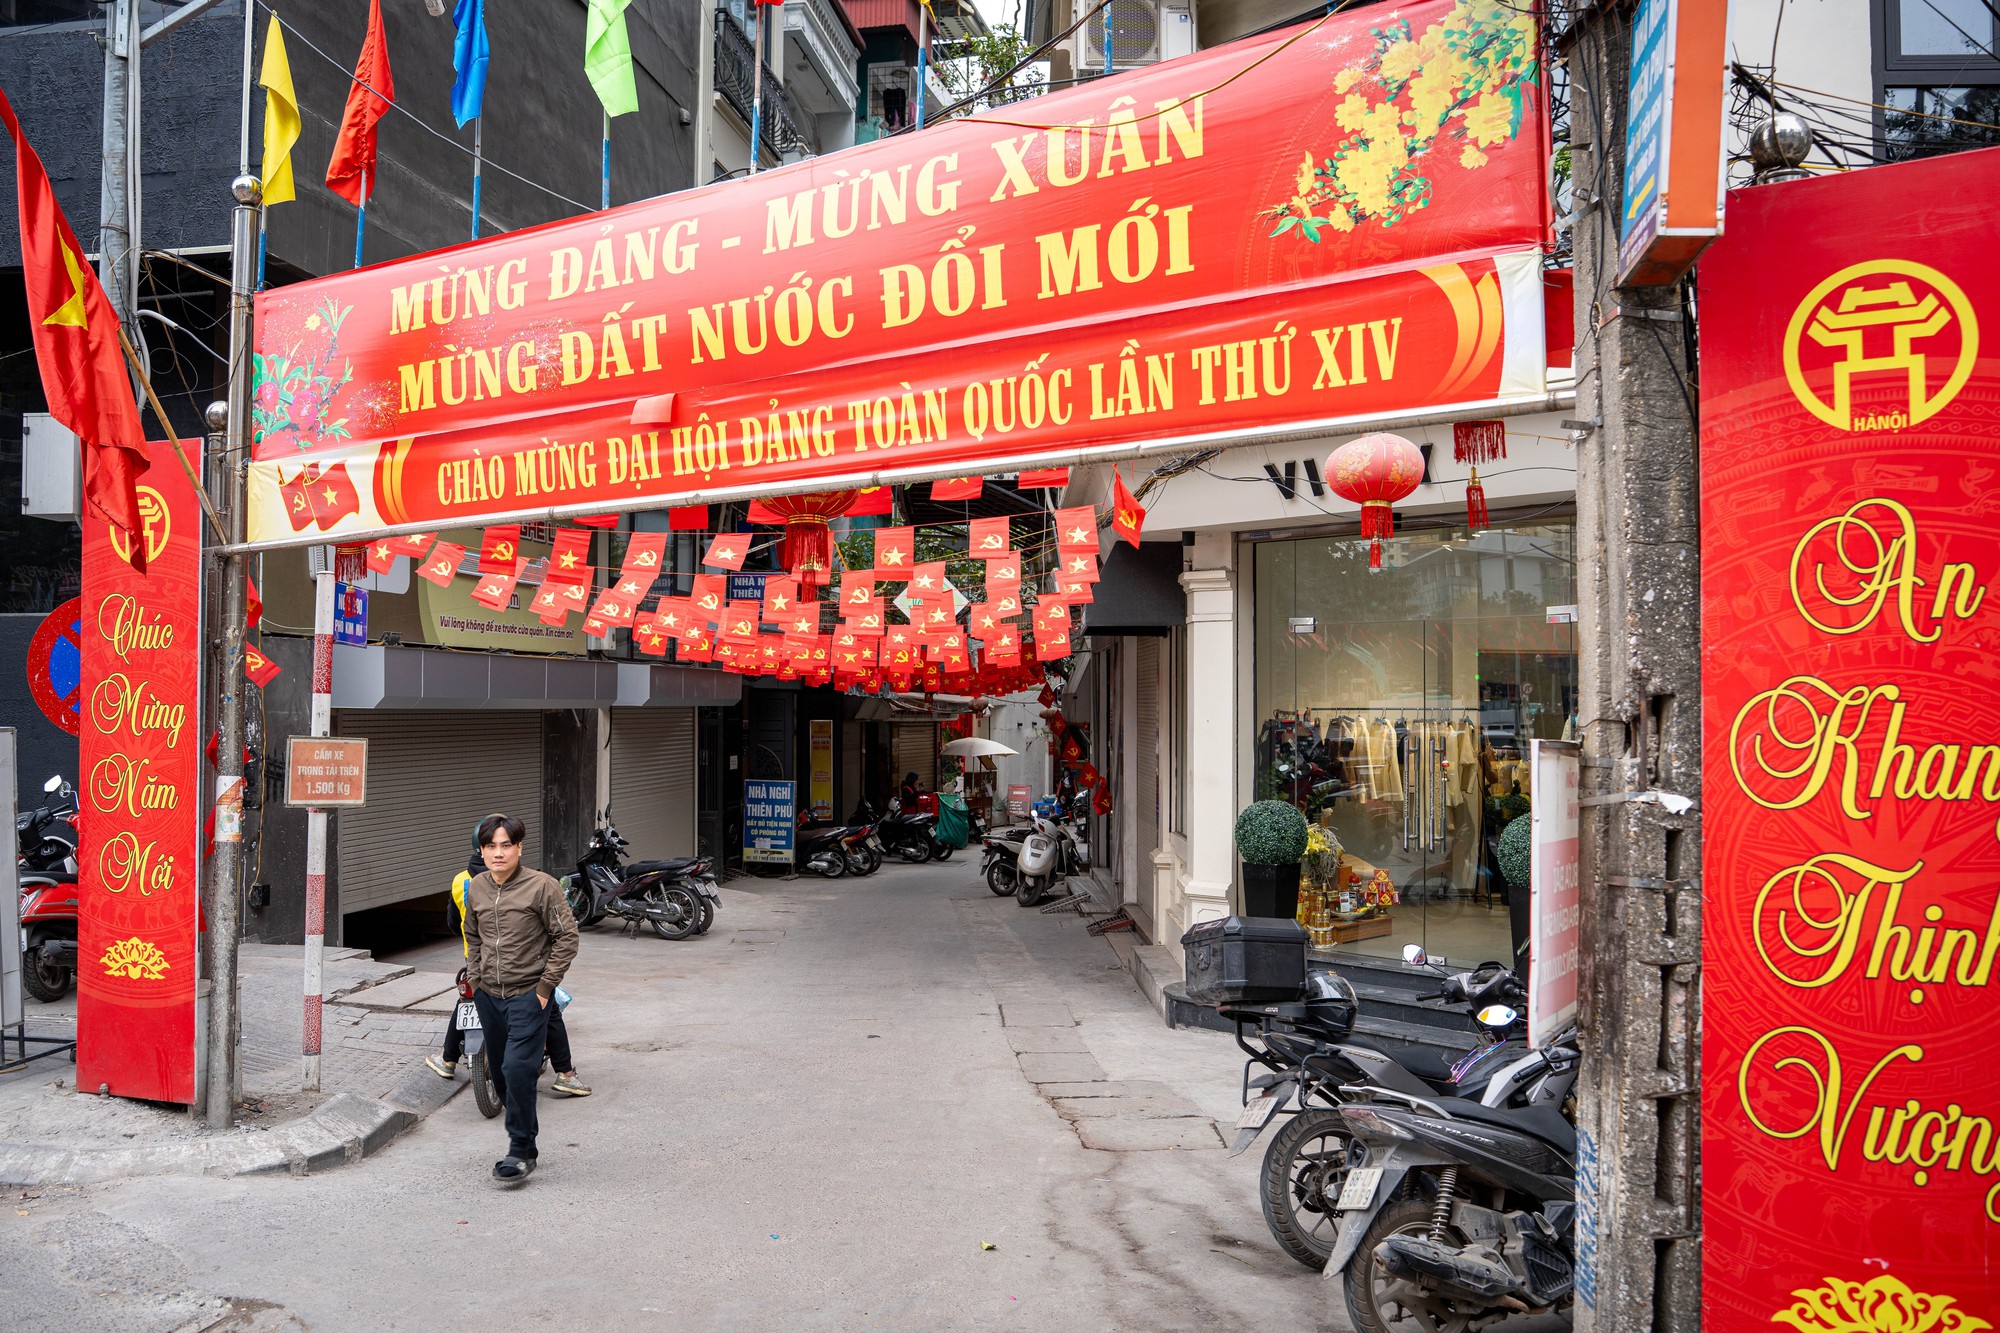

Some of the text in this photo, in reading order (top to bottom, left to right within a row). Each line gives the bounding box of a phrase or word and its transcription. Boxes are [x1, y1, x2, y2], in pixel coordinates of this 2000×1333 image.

[390, 260, 528, 335] MỪNG
[549, 219, 700, 301] ĐẢNG
[762, 152, 962, 254] MỪNG
[990, 92, 1208, 203] XUÂN
[399, 197, 1195, 414] MỪNG ĐẤT NƯỚC ĐỔI MỚI
[438, 318, 1403, 506] CHÀO MỪNG ĐẠI HỘI ĐẢNG TOÀN QUỐC LẦN THỨ XIV
[1789, 497, 1986, 643] An
[98, 593, 174, 666] Chúc
[440, 616, 450, 628] Vui
[451, 617, 465, 633] lòng
[465, 619, 485, 634] không
[485, 619, 494, 632] để
[494, 624, 502, 632] xe
[502, 624, 517, 635] trước
[545, 627, 554, 637] Xin
[90, 672, 186, 749] Mừng
[89, 752, 178, 819] Năm
[297, 763, 359, 778] TRỌNG TẢI TRÊN
[314, 747, 344, 760] CẤM XE
[1728, 675, 2000, 841] Khan
[306, 782, 350, 795] 1.500 Kg
[747, 802, 793, 818] THIÊN PHÚ
[748, 783, 791, 800] NHÀ NGHỈ
[99, 830, 174, 897] Mới
[463, 1005, 475, 1016] 37
[1738, 1025, 2000, 1222] Vượn
